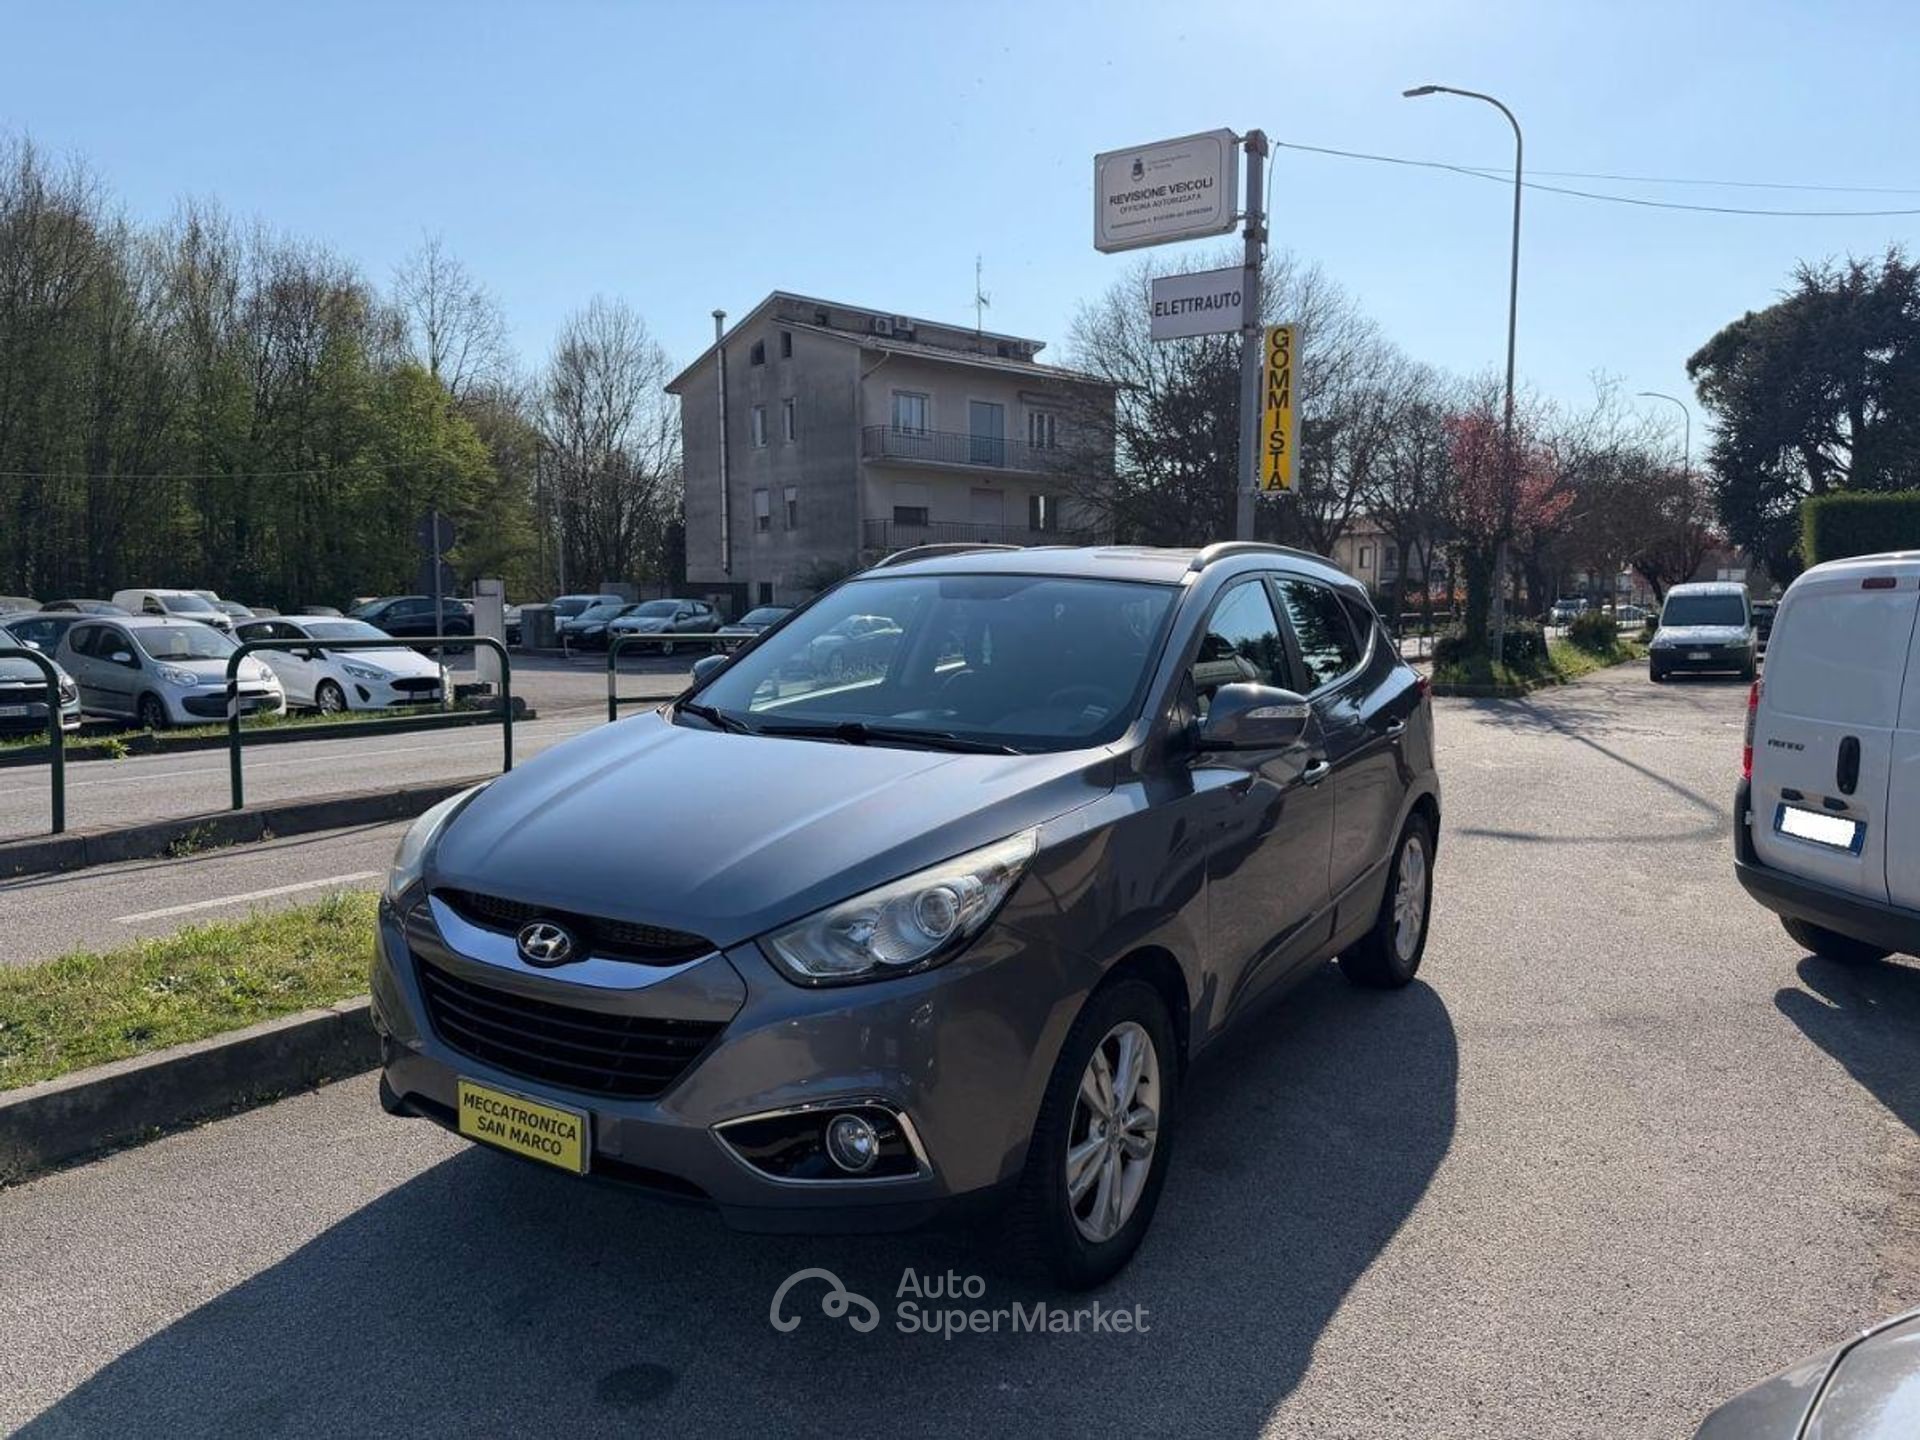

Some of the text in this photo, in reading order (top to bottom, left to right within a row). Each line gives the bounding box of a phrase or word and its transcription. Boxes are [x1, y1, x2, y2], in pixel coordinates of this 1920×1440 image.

[1109, 176, 1213, 205] REVISIONE VEICOLI
[1120, 193, 1201, 214] OFFICINA AUTORIZZATA
[1154, 291, 1241, 317] ELETTRAUTO
[1267, 328, 1290, 491] GOMMISTA
[463, 1092, 577, 1141] MECCATRONICA
[477, 1116, 562, 1156] SAN MARCO
